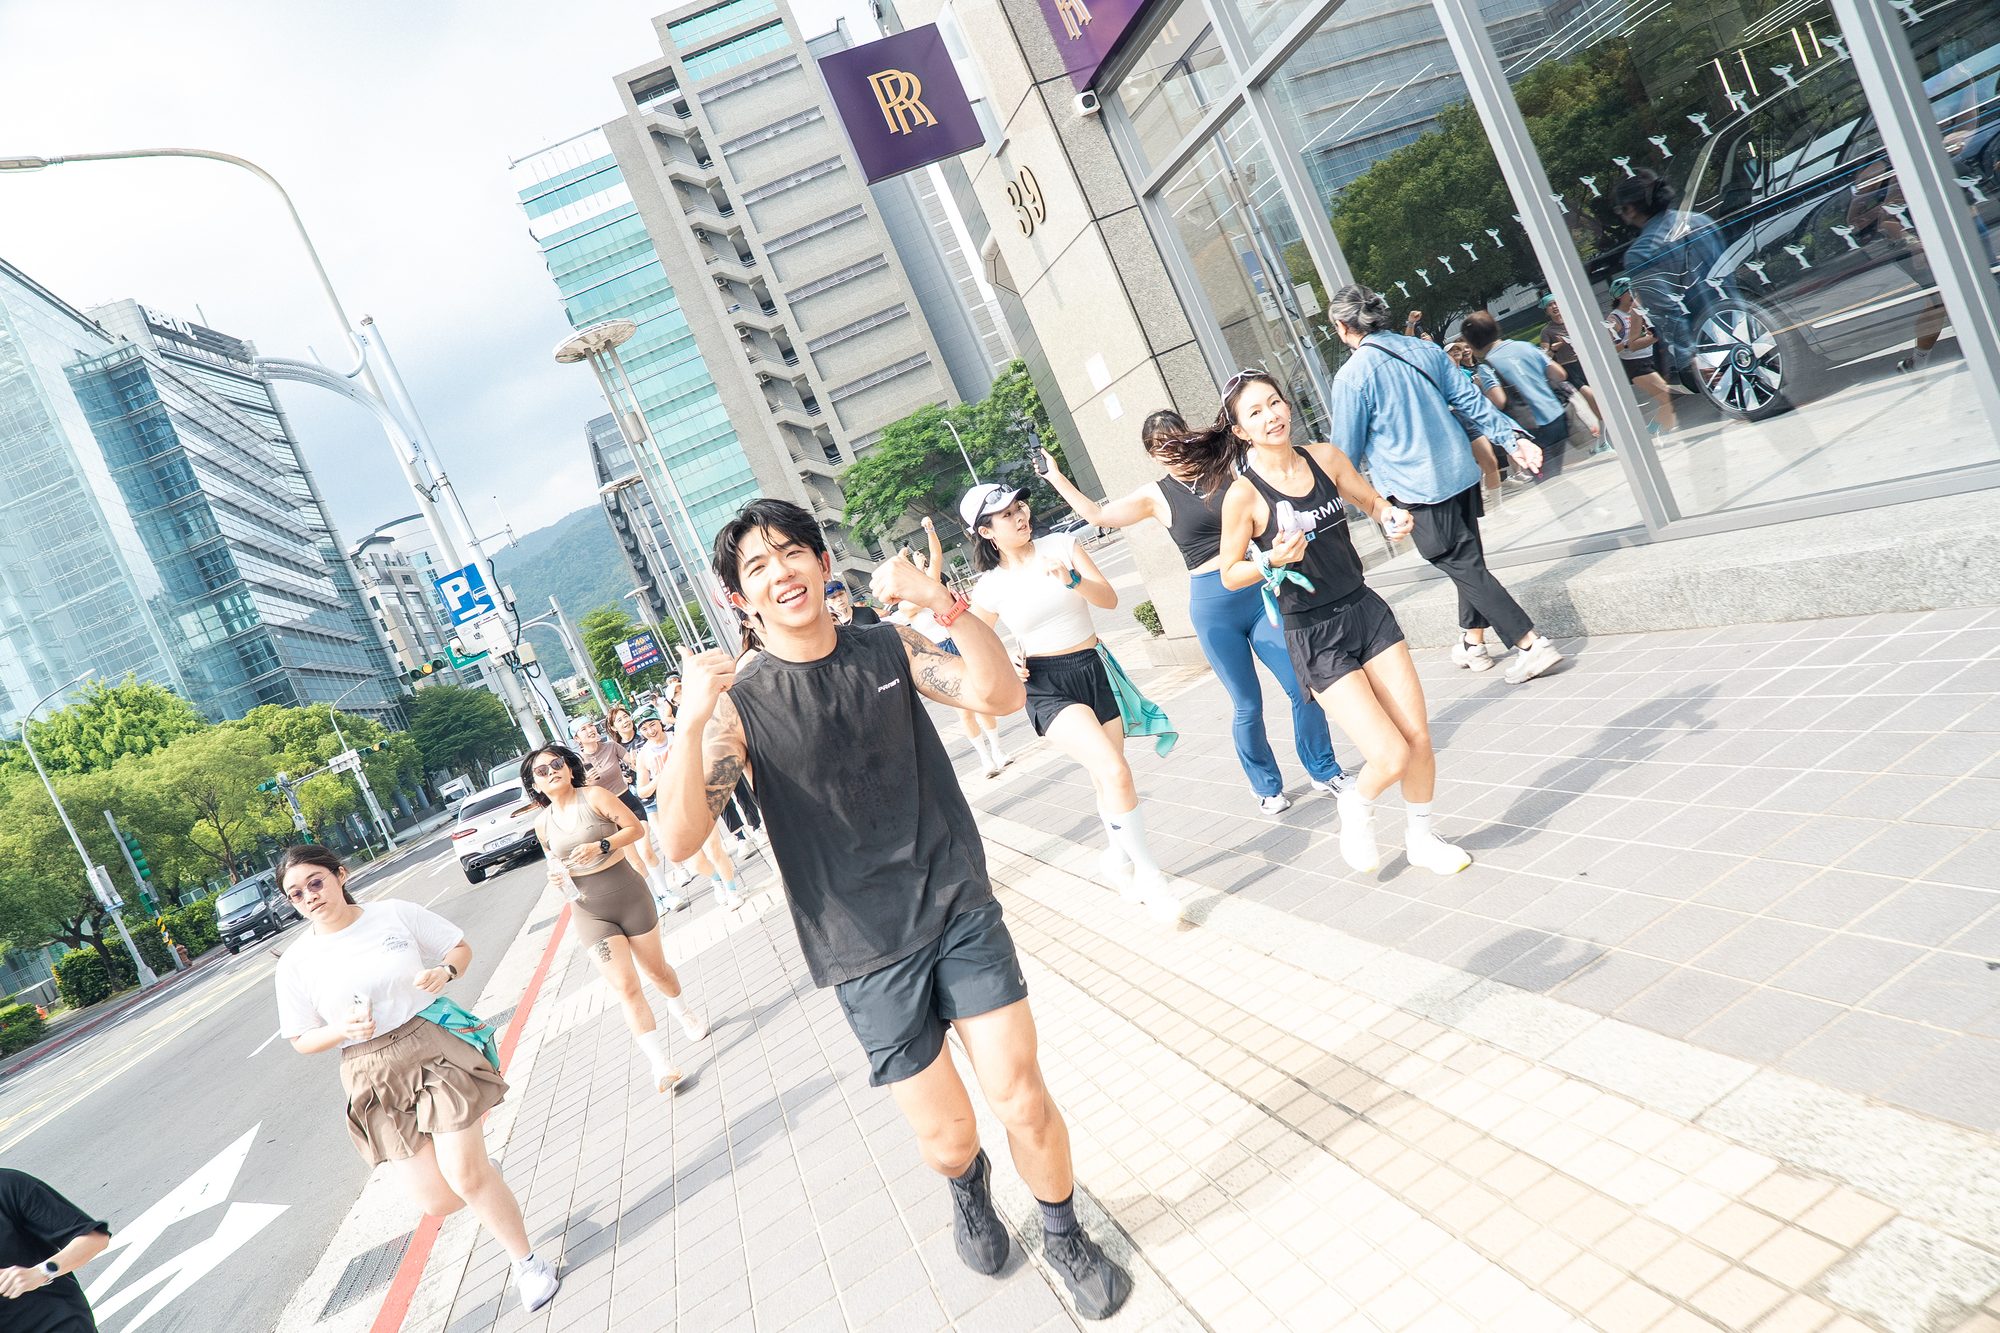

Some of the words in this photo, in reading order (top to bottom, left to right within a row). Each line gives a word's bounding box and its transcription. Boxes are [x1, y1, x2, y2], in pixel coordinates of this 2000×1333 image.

[1007, 165, 1046, 238] 39
[1313, 496, 1343, 520] RMIN
[440, 576, 469, 612] P
